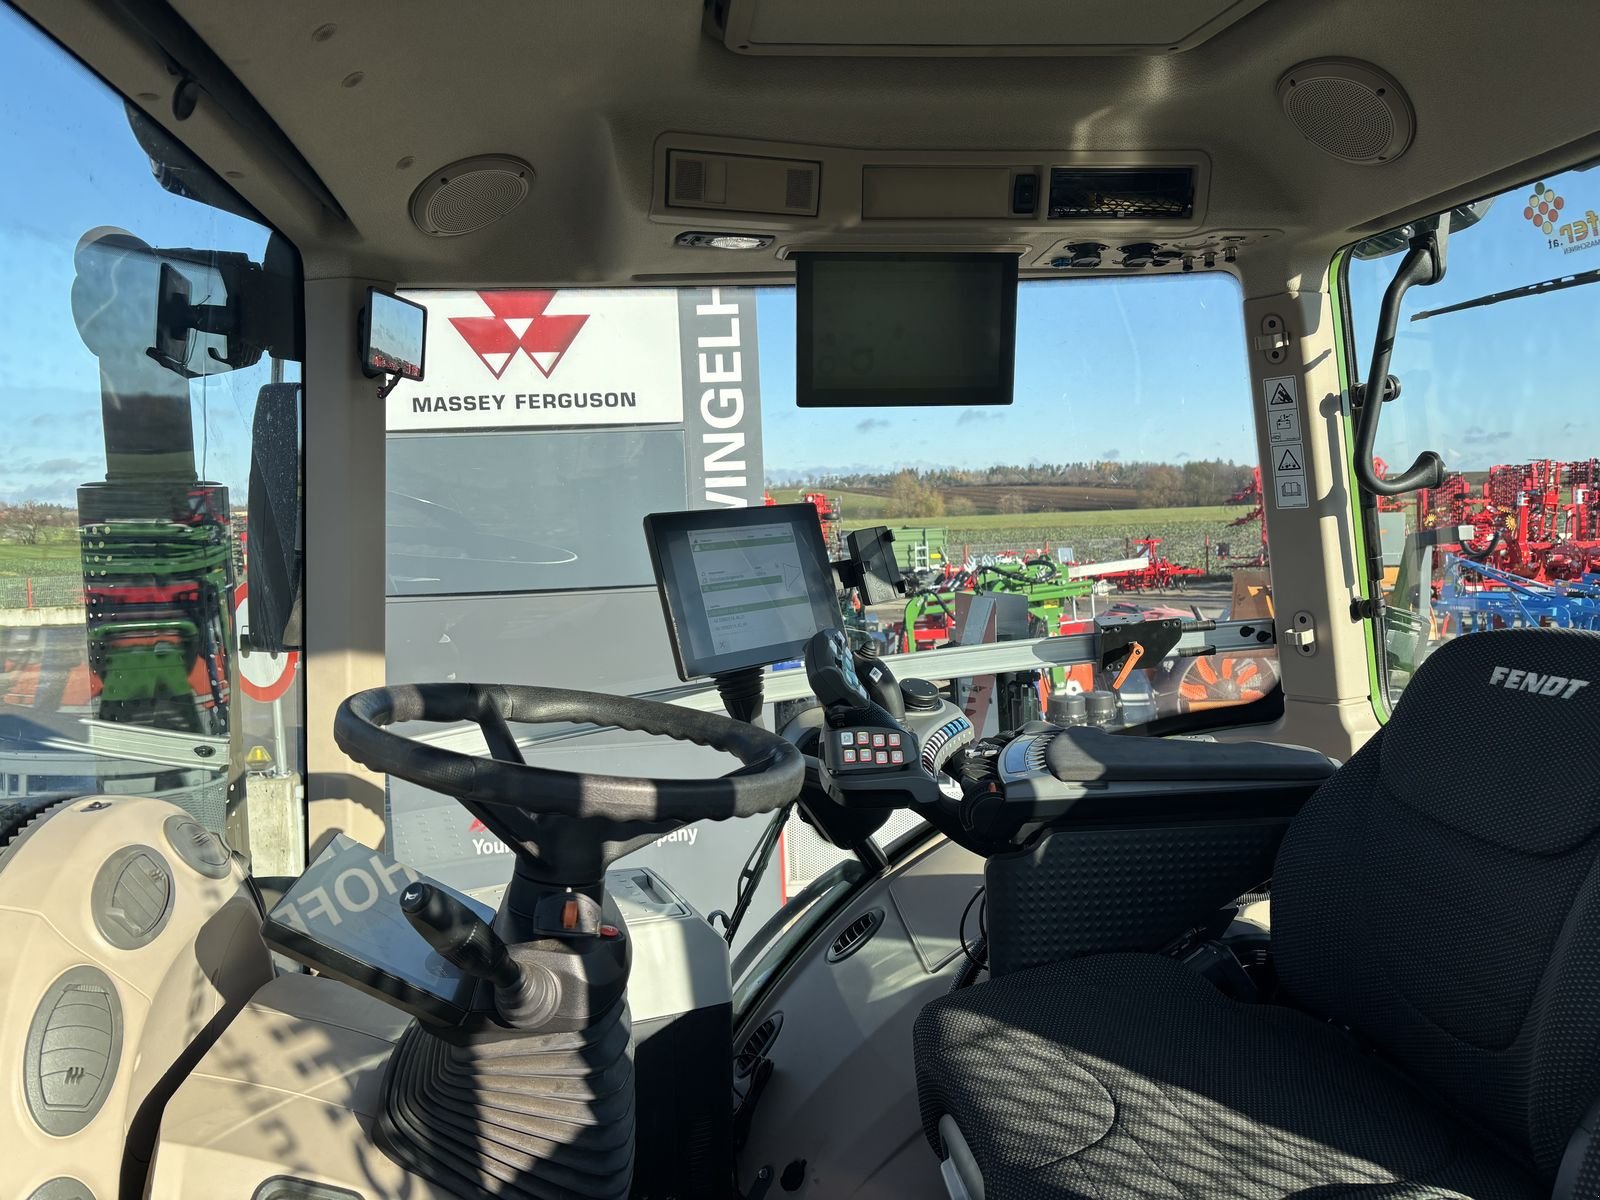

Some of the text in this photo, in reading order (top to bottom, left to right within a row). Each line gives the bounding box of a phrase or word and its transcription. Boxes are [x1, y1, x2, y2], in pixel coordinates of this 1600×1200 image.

[412, 391, 637, 413] MASSEY FERGUSON
[1489, 666, 1591, 700] FENDT
